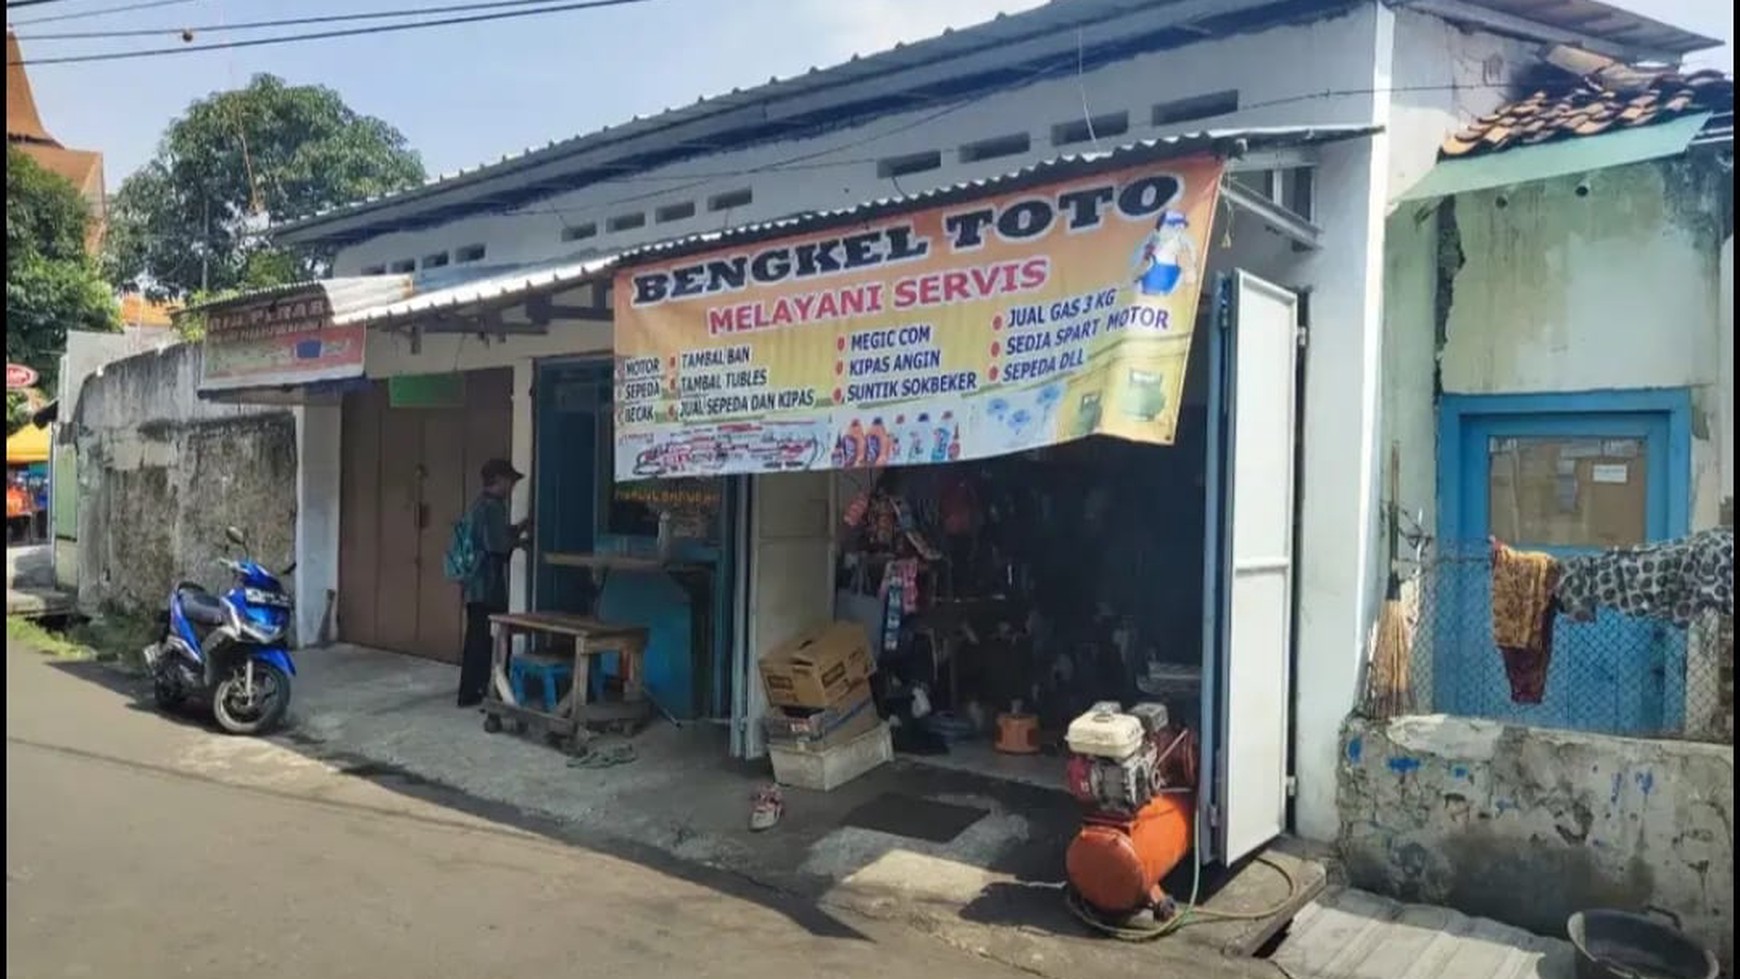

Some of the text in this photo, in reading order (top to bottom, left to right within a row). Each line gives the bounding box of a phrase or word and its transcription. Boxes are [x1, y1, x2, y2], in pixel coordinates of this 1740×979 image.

[633, 176, 1180, 304] BENGKEL TOTO
[709, 259, 1048, 335] MELAYANI SERVIS
[1007, 288, 1117, 328] JUAL GAS 3 KG
[851, 325, 931, 351] MEGIC COM
[1006, 306, 1169, 355] SEDIA SPART MOTOR
[625, 358, 660, 375] MOTOR
[681, 346, 750, 369] TAMBAL BAN
[849, 350, 941, 376] KIPAS ANGIN
[1002, 348, 1084, 382] SEPEDA DLL
[625, 381, 660, 400] SEPEDA
[680, 368, 767, 392] TAMBAL TUBLES
[847, 371, 977, 402] SUNTIK SOKBEKER
[679, 388, 816, 417] JUAL SEPEDA DAN KIPAS
